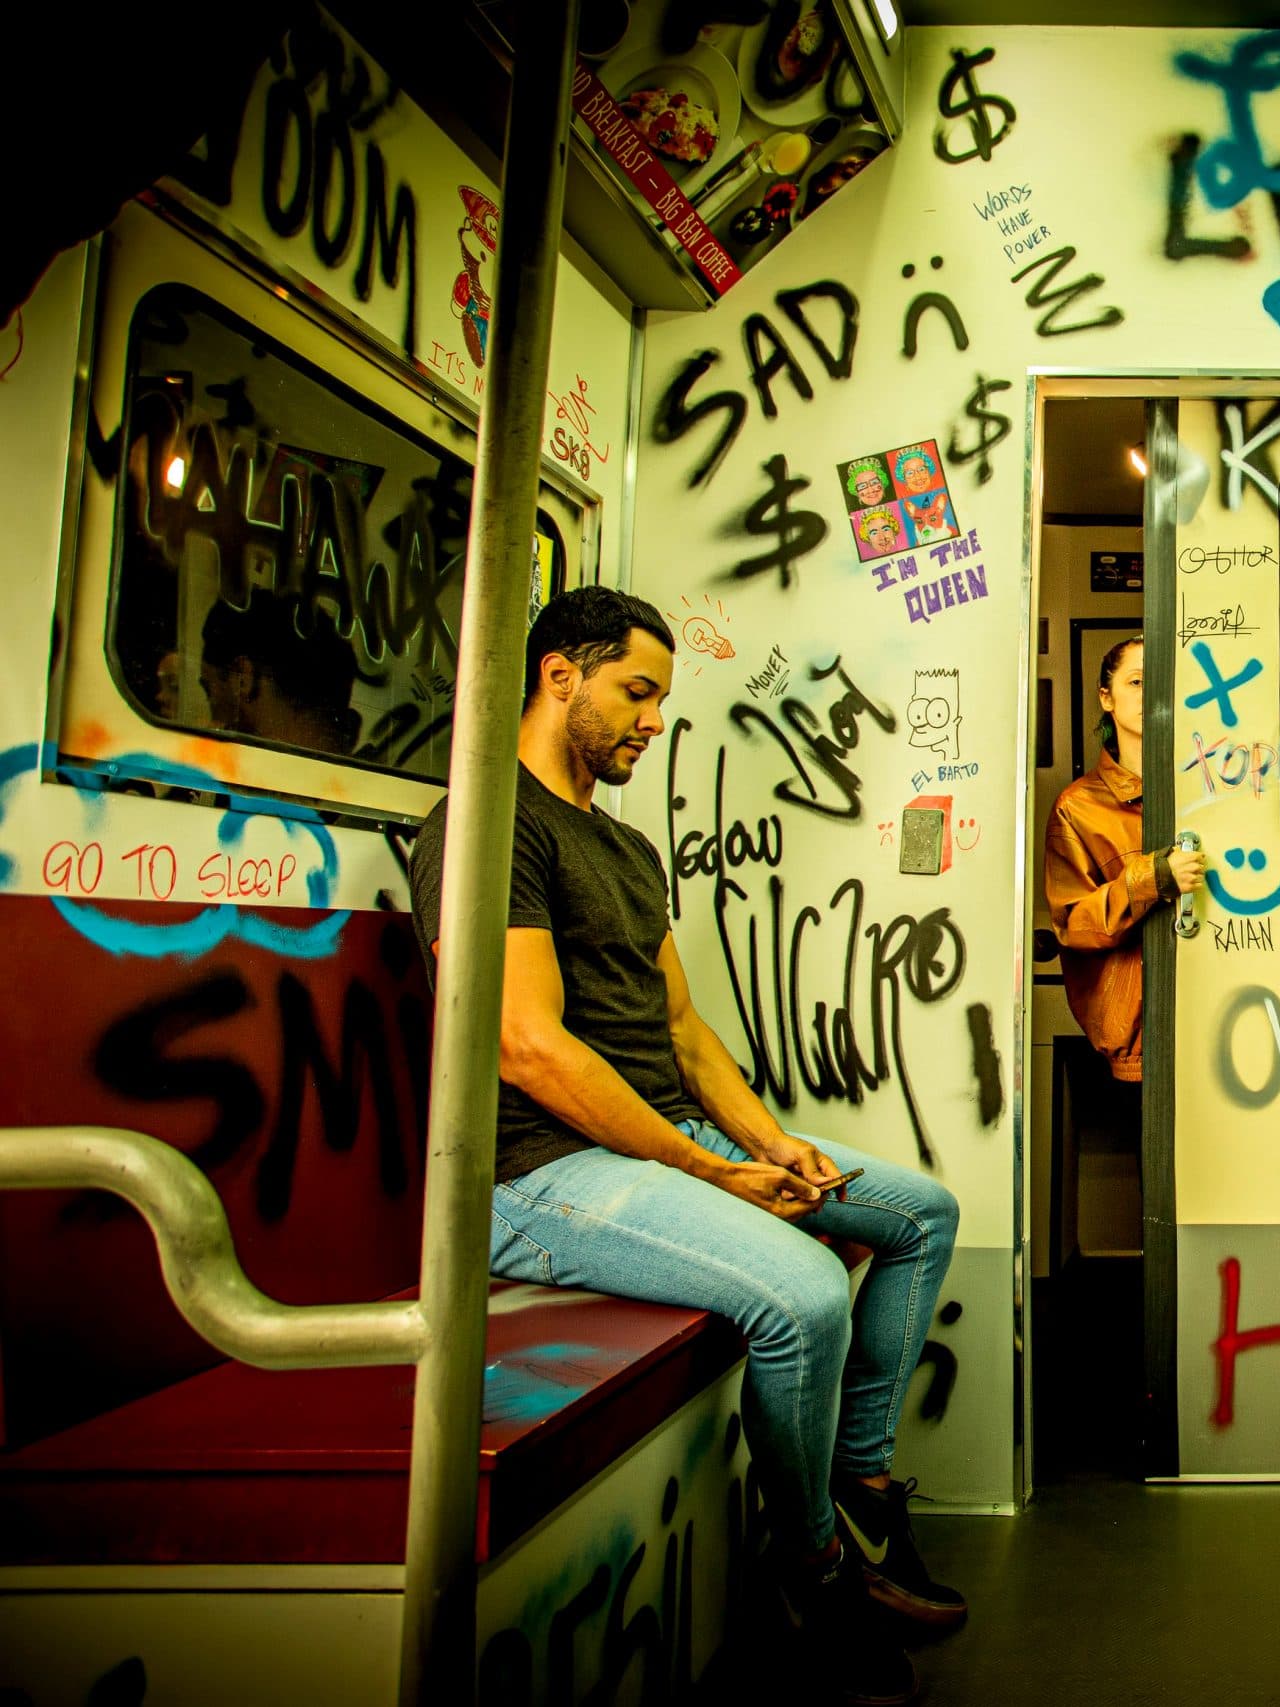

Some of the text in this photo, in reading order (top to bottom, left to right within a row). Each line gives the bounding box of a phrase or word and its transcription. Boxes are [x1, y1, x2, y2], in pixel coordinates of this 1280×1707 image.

[580, 89, 654, 175] BREAKFAST
[655, 186, 680, 222] BIG
[675, 212, 706, 250] BEN
[696, 240, 735, 285] COFFEE
[973, 183, 1032, 222] WORDS
[997, 208, 1033, 237] HAVE
[1002, 224, 1052, 266] POWER
[428, 340, 466, 386] IT'S
[652, 279, 861, 491] SAD
[871, 528, 983, 593] I'M THE
[903, 563, 989, 624] QUEEN
[744, 643, 790, 699] MONEY
[910, 762, 980, 793] EL BARTO
[42, 840, 104, 895] GO
[121, 843, 177, 900] TO
